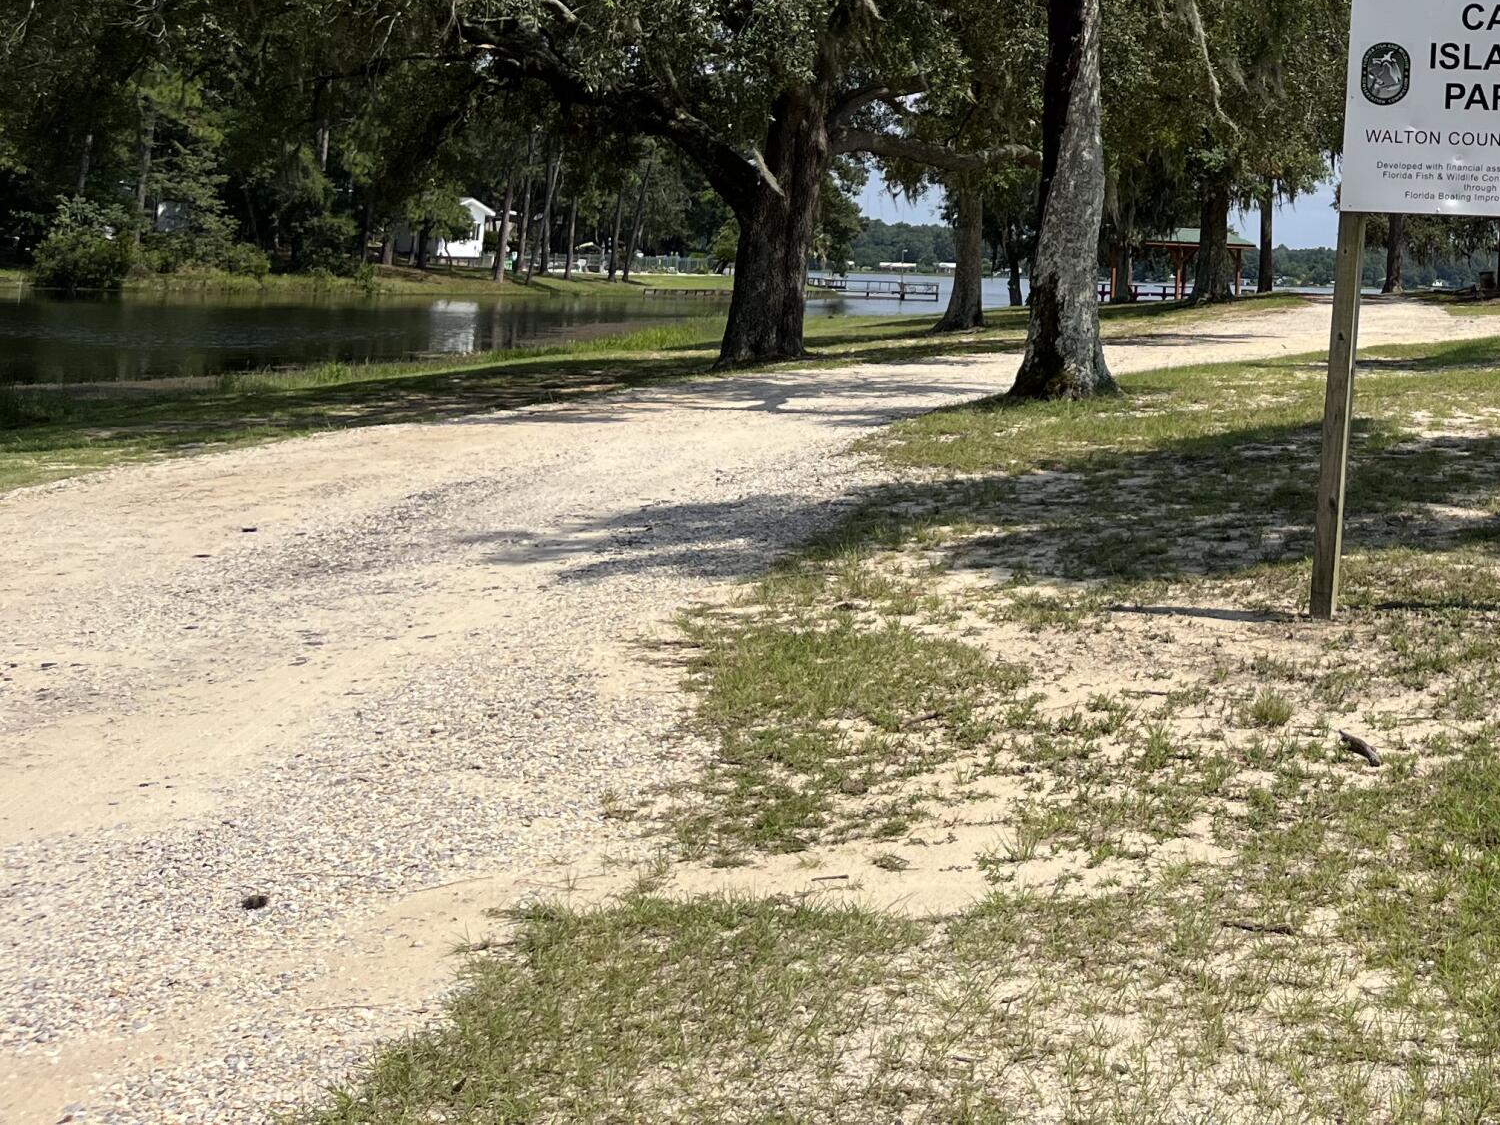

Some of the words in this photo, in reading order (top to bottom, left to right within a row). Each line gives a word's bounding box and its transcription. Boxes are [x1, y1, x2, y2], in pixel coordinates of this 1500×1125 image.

[1365, 129, 1441, 145] WALTON
[1376, 161, 1423, 171] Developed
[1425, 162, 1443, 171] with
[1446, 163, 1483, 173] financial
[1382, 170, 1413, 180] Florida
[1415, 171, 1434, 180] Fish
[1436, 172, 1443, 181] &
[1446, 173, 1479, 182] Wildlife
[1463, 183, 1497, 193] through
[1404, 190, 1435, 200] Florida
[1438, 192, 1472, 203] Boating
